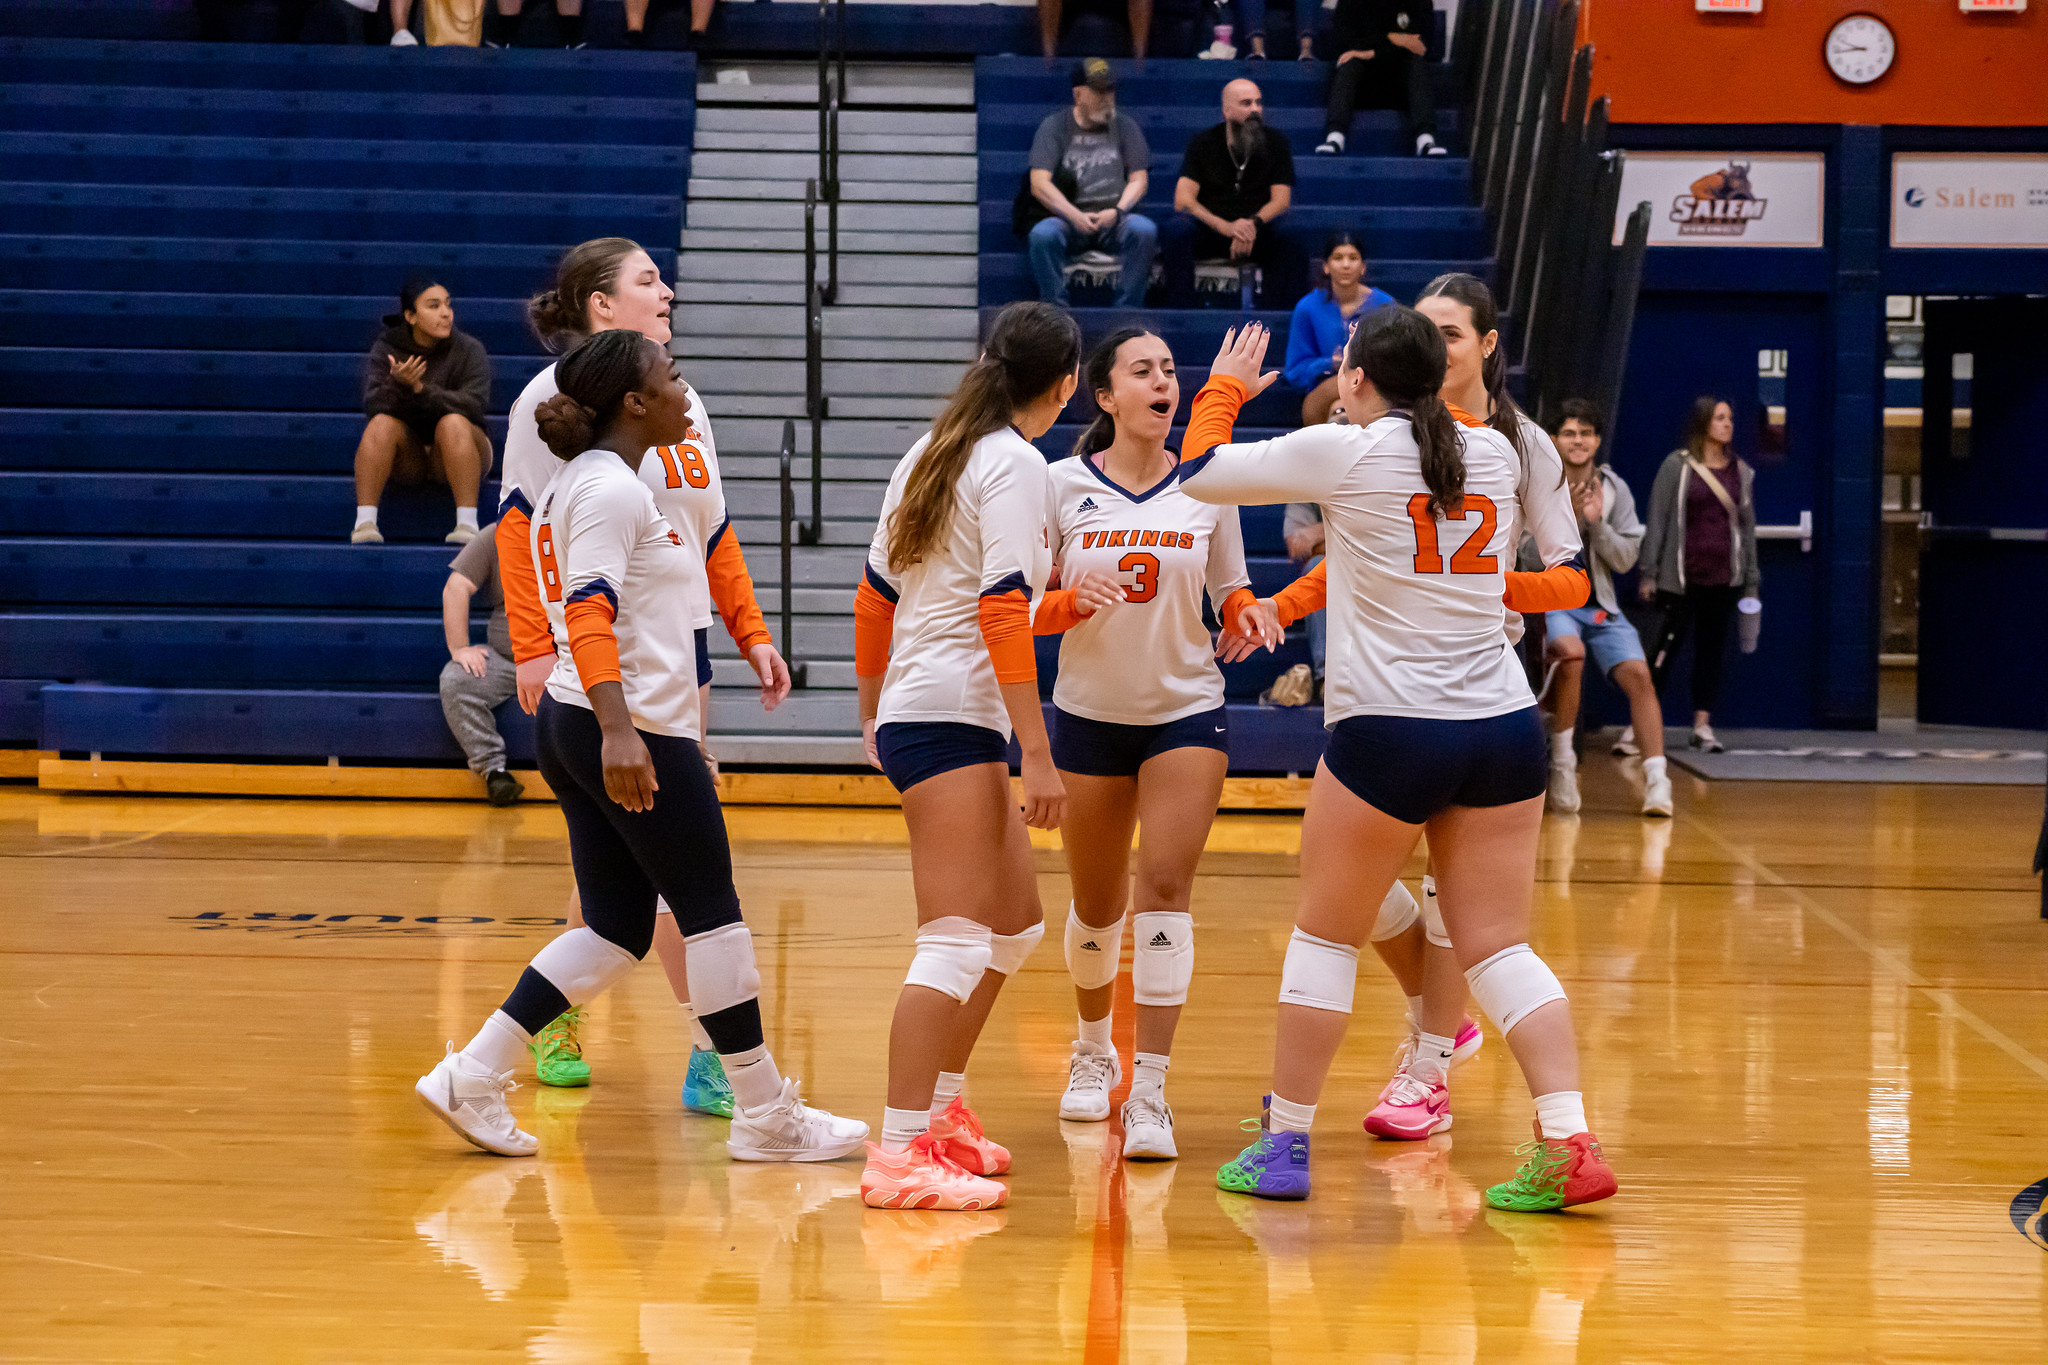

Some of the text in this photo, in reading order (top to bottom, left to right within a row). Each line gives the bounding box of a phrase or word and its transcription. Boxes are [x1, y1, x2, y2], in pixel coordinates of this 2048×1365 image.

[1669, 195, 1767, 222] SALEM
[1936, 187, 2014, 208] Salem
[656, 443, 710, 489] 18
[1077, 504, 1099, 513] adidas
[1082, 530, 1195, 550] VIKINGS
[1406, 493, 1499, 574] 12
[537, 523, 563, 603] 8
[1118, 552, 1160, 603] 3
